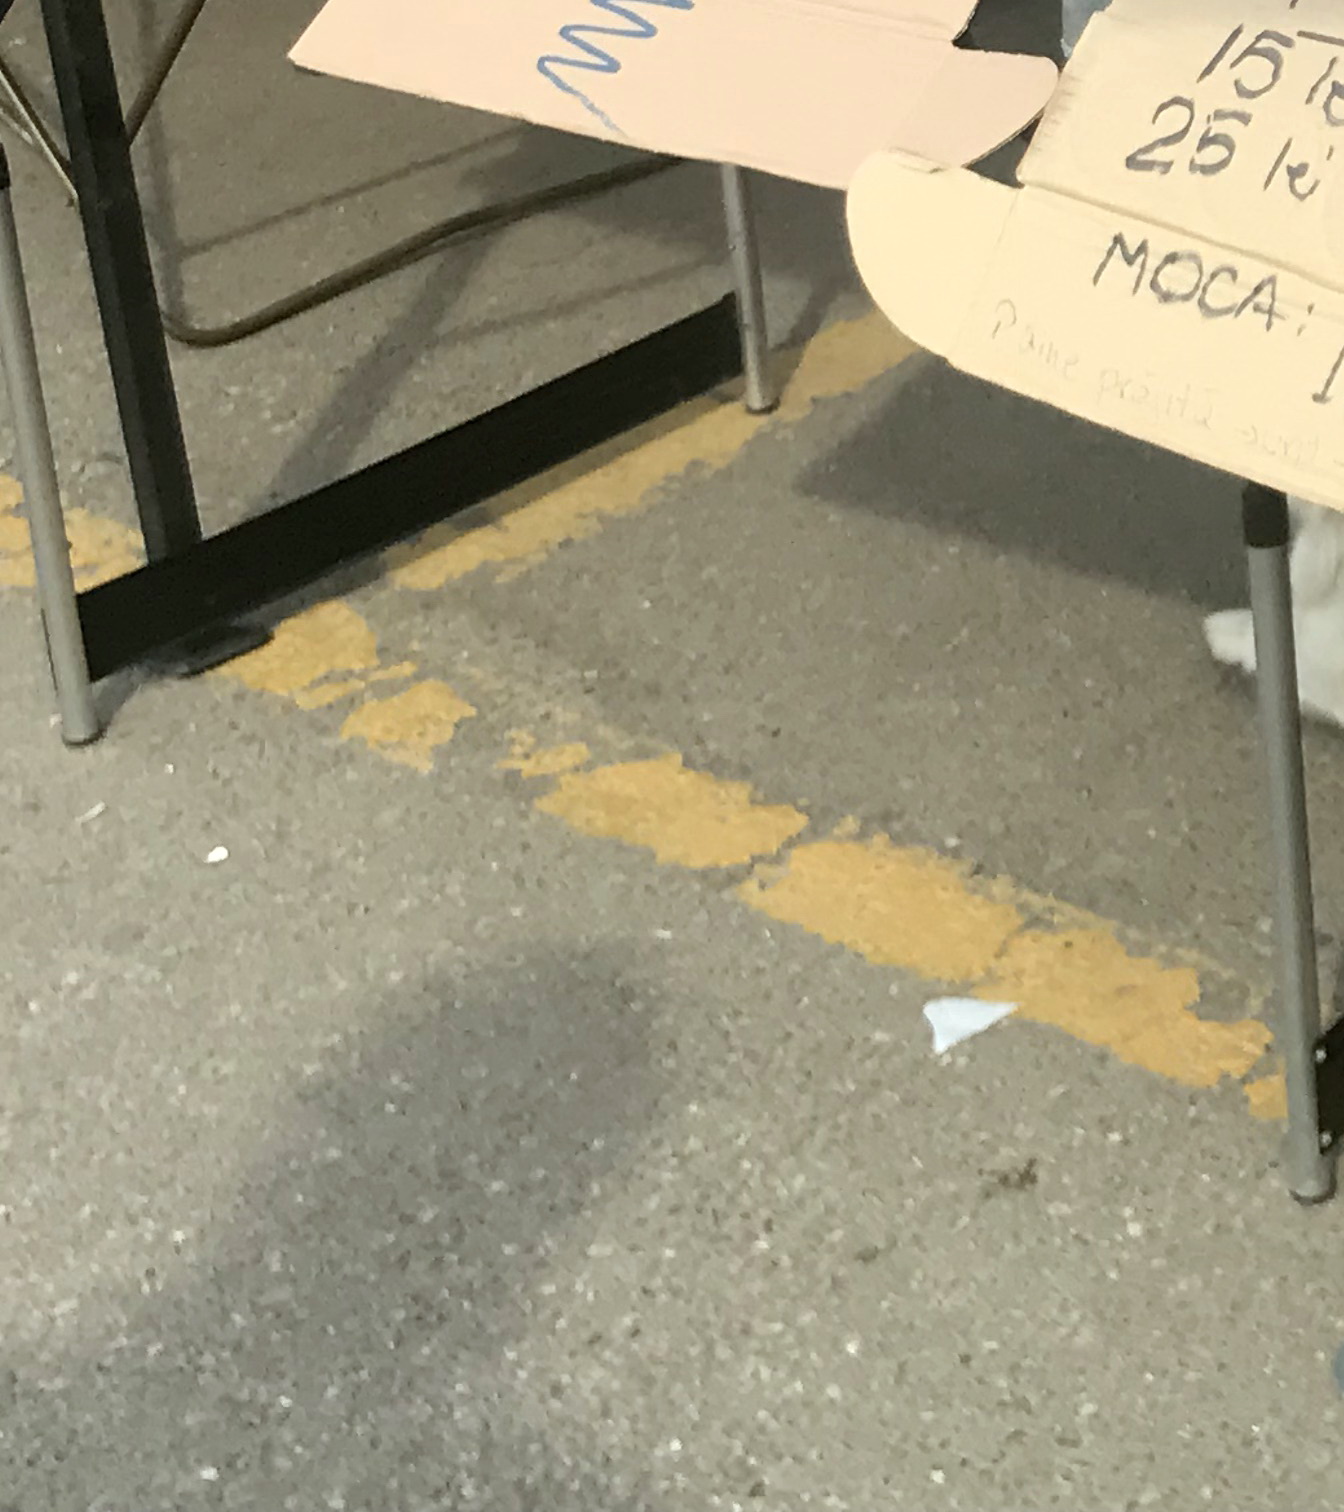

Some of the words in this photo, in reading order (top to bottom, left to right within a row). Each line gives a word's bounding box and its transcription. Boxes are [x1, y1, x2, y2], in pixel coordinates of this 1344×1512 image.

[1200, 22, 1300, 96] 15
[1124, 94, 1253, 175] 25
[1261, 140, 1338, 204] lei
